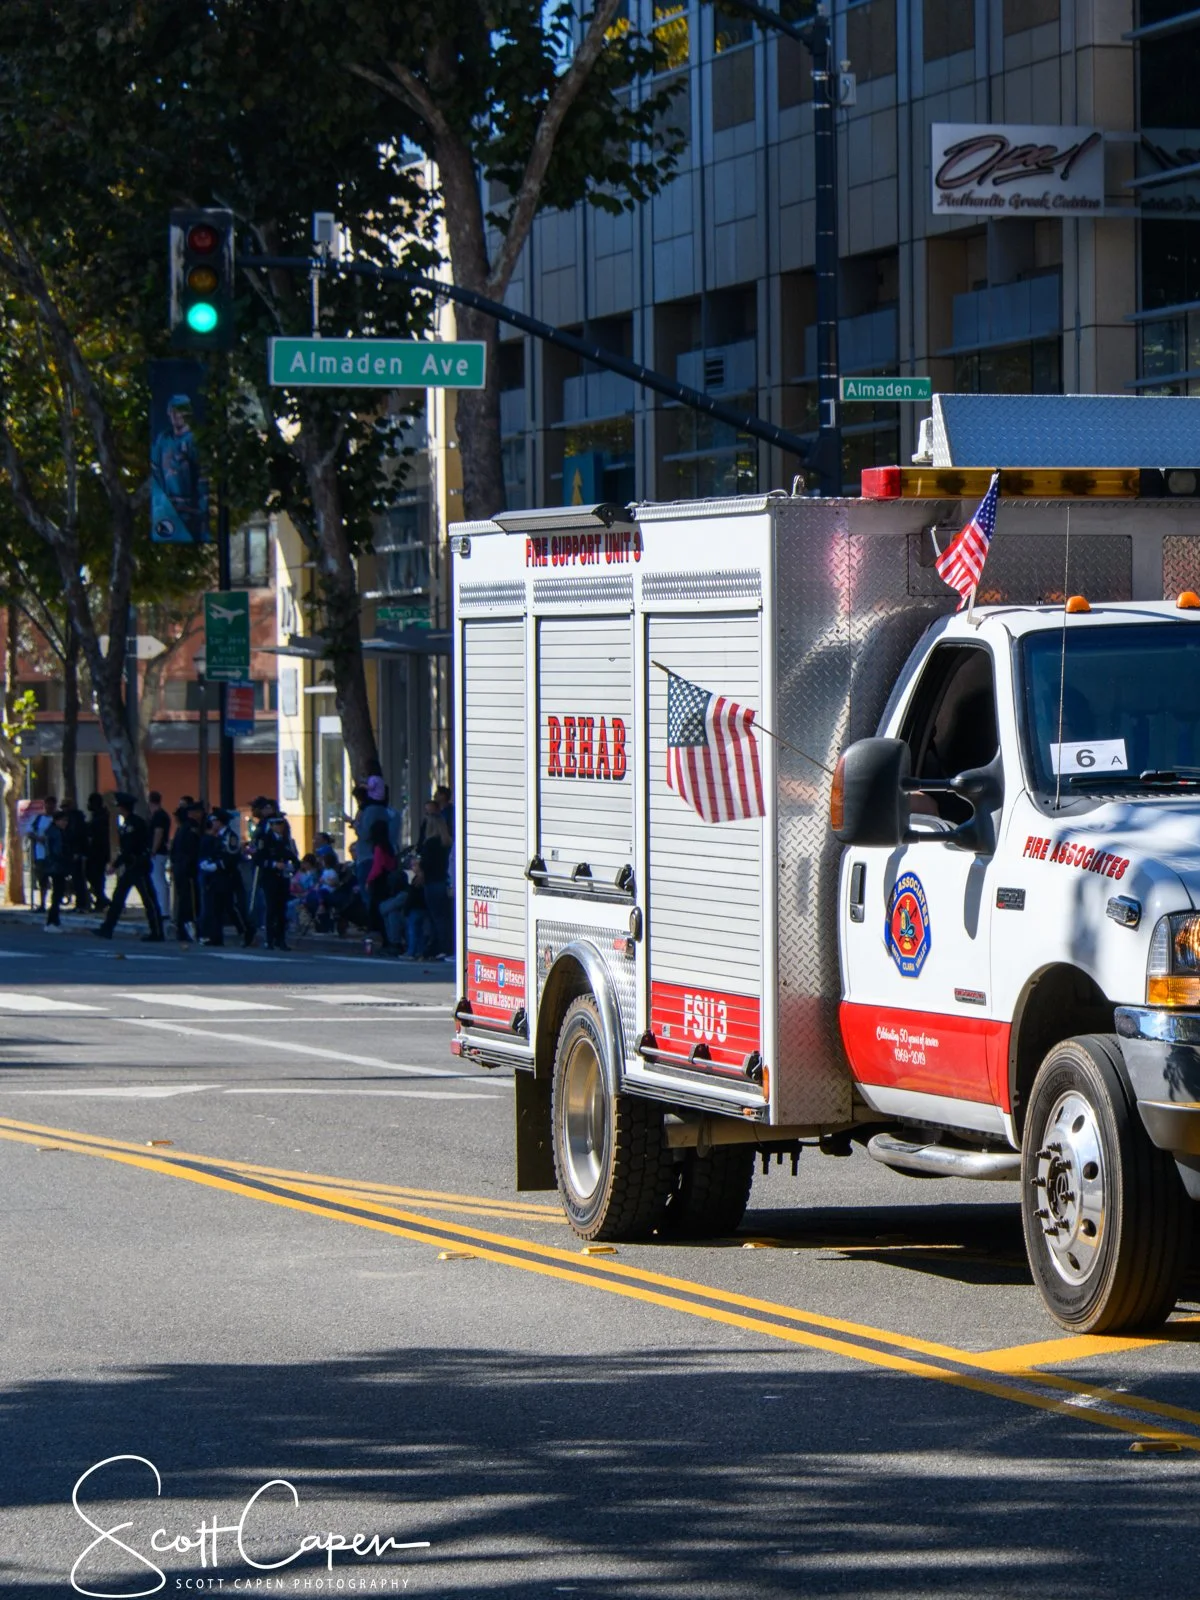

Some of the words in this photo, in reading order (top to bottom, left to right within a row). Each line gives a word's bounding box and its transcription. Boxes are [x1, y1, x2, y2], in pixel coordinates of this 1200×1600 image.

[937, 189, 1005, 209] Authentic
[1008, 191, 1051, 210] Greek
[290, 351, 402, 374] Almaden
[421, 353, 469, 376] Ave
[846, 382, 912, 396] Almaden
[525, 537, 548, 567] FIRE
[551, 533, 602, 567] SUPPORT
[604, 532, 631, 565] UNIT
[633, 531, 641, 563] 3
[547, 716, 627, 780] REHAB
[1076, 749, 1096, 768] 6
[1111, 755, 1123, 765] A
[1022, 835, 1051, 860] FIRE
[1049, 840, 1130, 880] ASSOCIATES
[470, 884, 499, 899] EMERGENCY
[473, 899, 489, 930] 911
[683, 993, 715, 1041] FSU
[716, 1000, 728, 1043] 3
[899, 1028, 908, 1043] 50
[894, 1048, 926, 1065] 1969-2019
